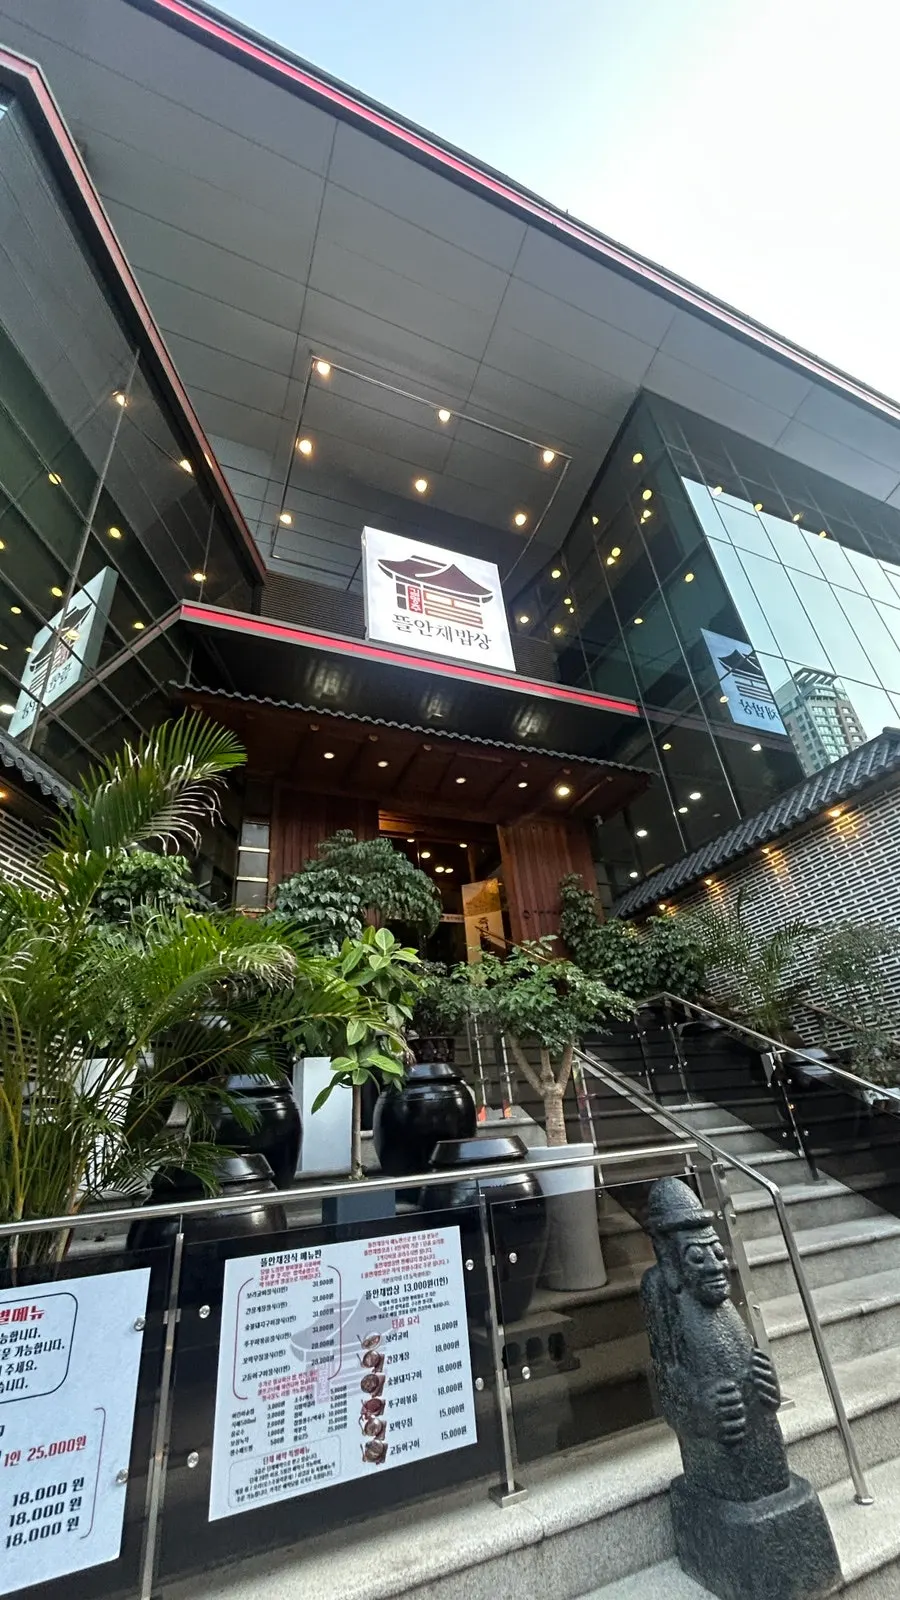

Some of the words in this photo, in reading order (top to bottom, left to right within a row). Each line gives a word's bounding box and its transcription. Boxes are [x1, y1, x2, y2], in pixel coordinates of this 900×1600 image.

[392, 613, 492, 650] 뜰안채밥상
[261, 1253, 298, 1267] 뜰안채정식
[301, 1250, 322, 1261] 메뉴판
[365, 1286, 400, 1300] 뜰안채밥상
[386, 1330, 409, 1343] 보리굴비
[14, 1339, 65, 1358] 가능합니다.
[387, 1351, 410, 1365] 간장게장
[5, 1360, 38, 1376] 주세요.
[388, 1370, 422, 1386] 숯불돼지구이
[390, 1439, 420, 1456] 고등어구이
[4, 1450, 21, 1467] 1인
[13, 1482, 67, 1507] 18.000
[72, 1477, 85, 1493] 원
[9, 1501, 65, 1528] 18.000
[69, 1496, 82, 1512] 원
[5, 1521, 62, 1549] 18.000
[67, 1516, 80, 1532] 원
